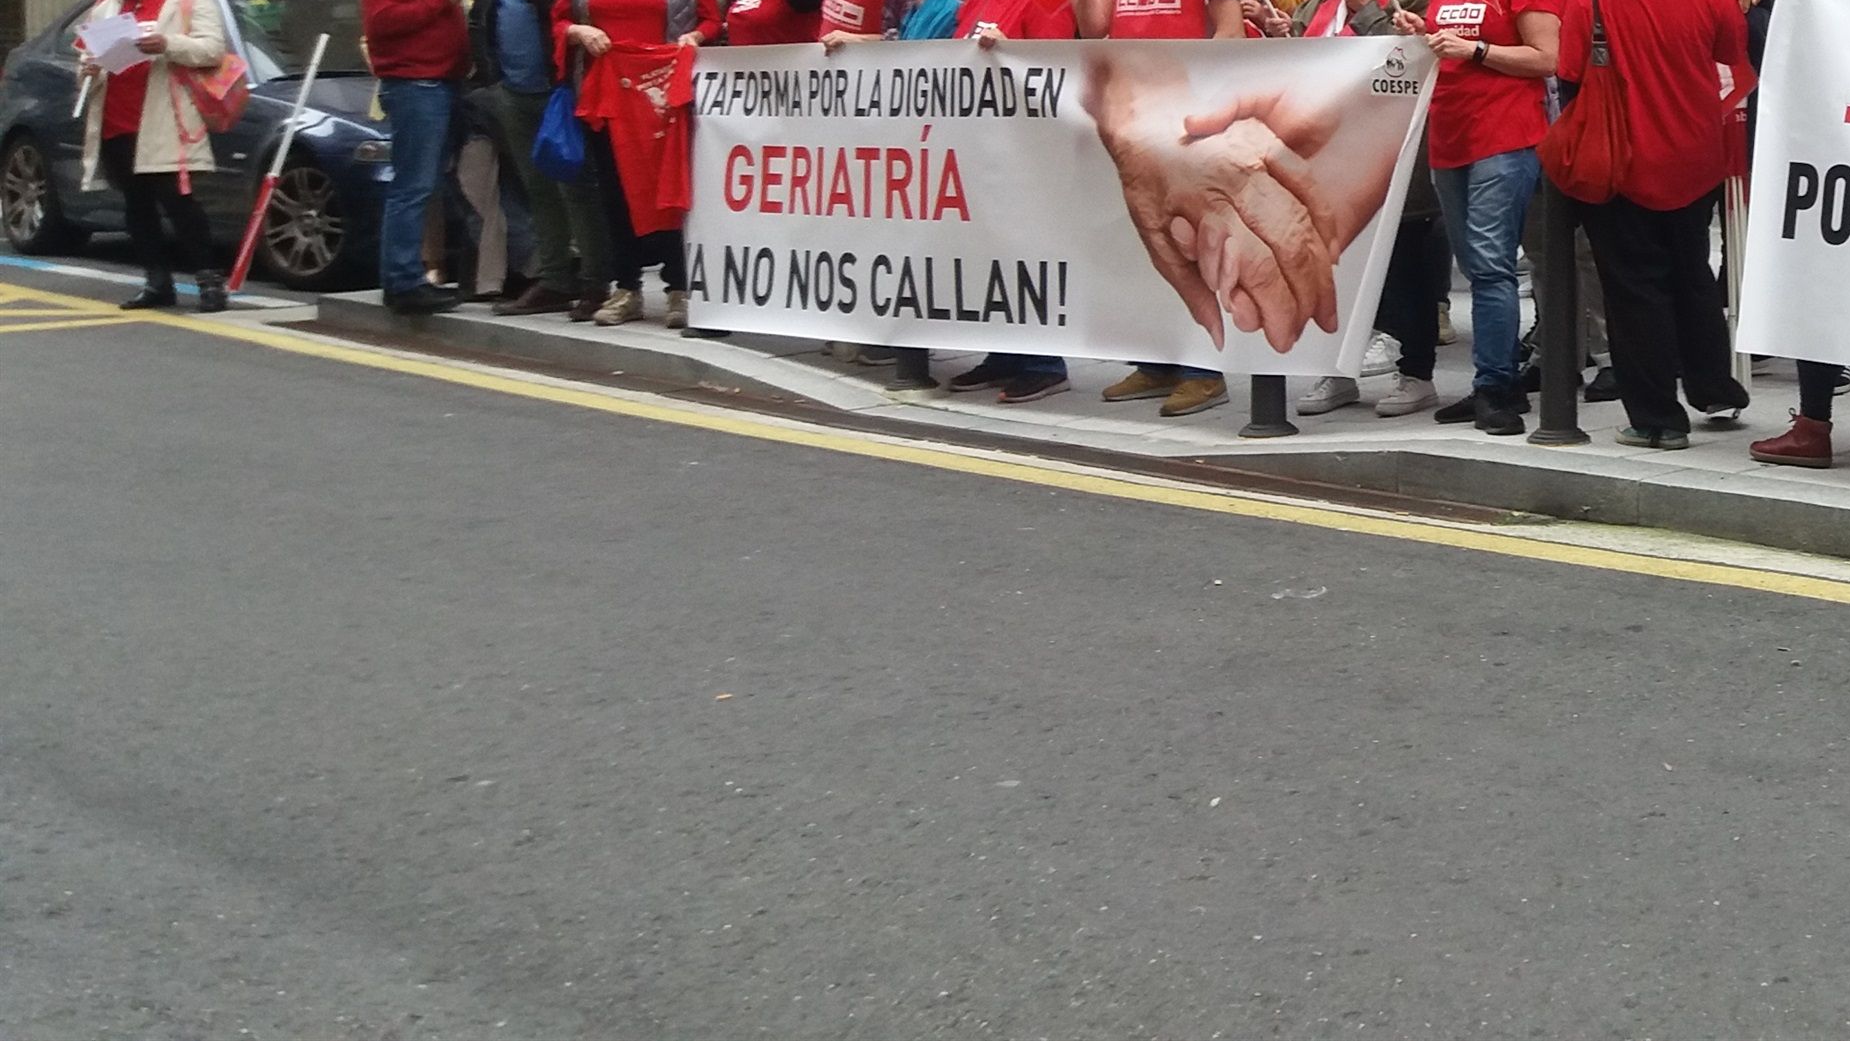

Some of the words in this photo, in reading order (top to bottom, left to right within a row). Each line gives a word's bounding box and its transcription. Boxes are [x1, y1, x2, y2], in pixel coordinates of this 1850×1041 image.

[808, 69, 848, 118] POR
[854, 69, 882, 118] LA
[889, 66, 1018, 118] DIGNIDAD
[1023, 67, 1067, 118] EN
[1372, 78, 1419, 94] COESPE
[723, 124, 971, 222] GERIATRÍA
[686, 242, 710, 302] A
[722, 244, 776, 307] NO
[785, 247, 858, 315] NOS
[869, 253, 1068, 327] CALLAN!
